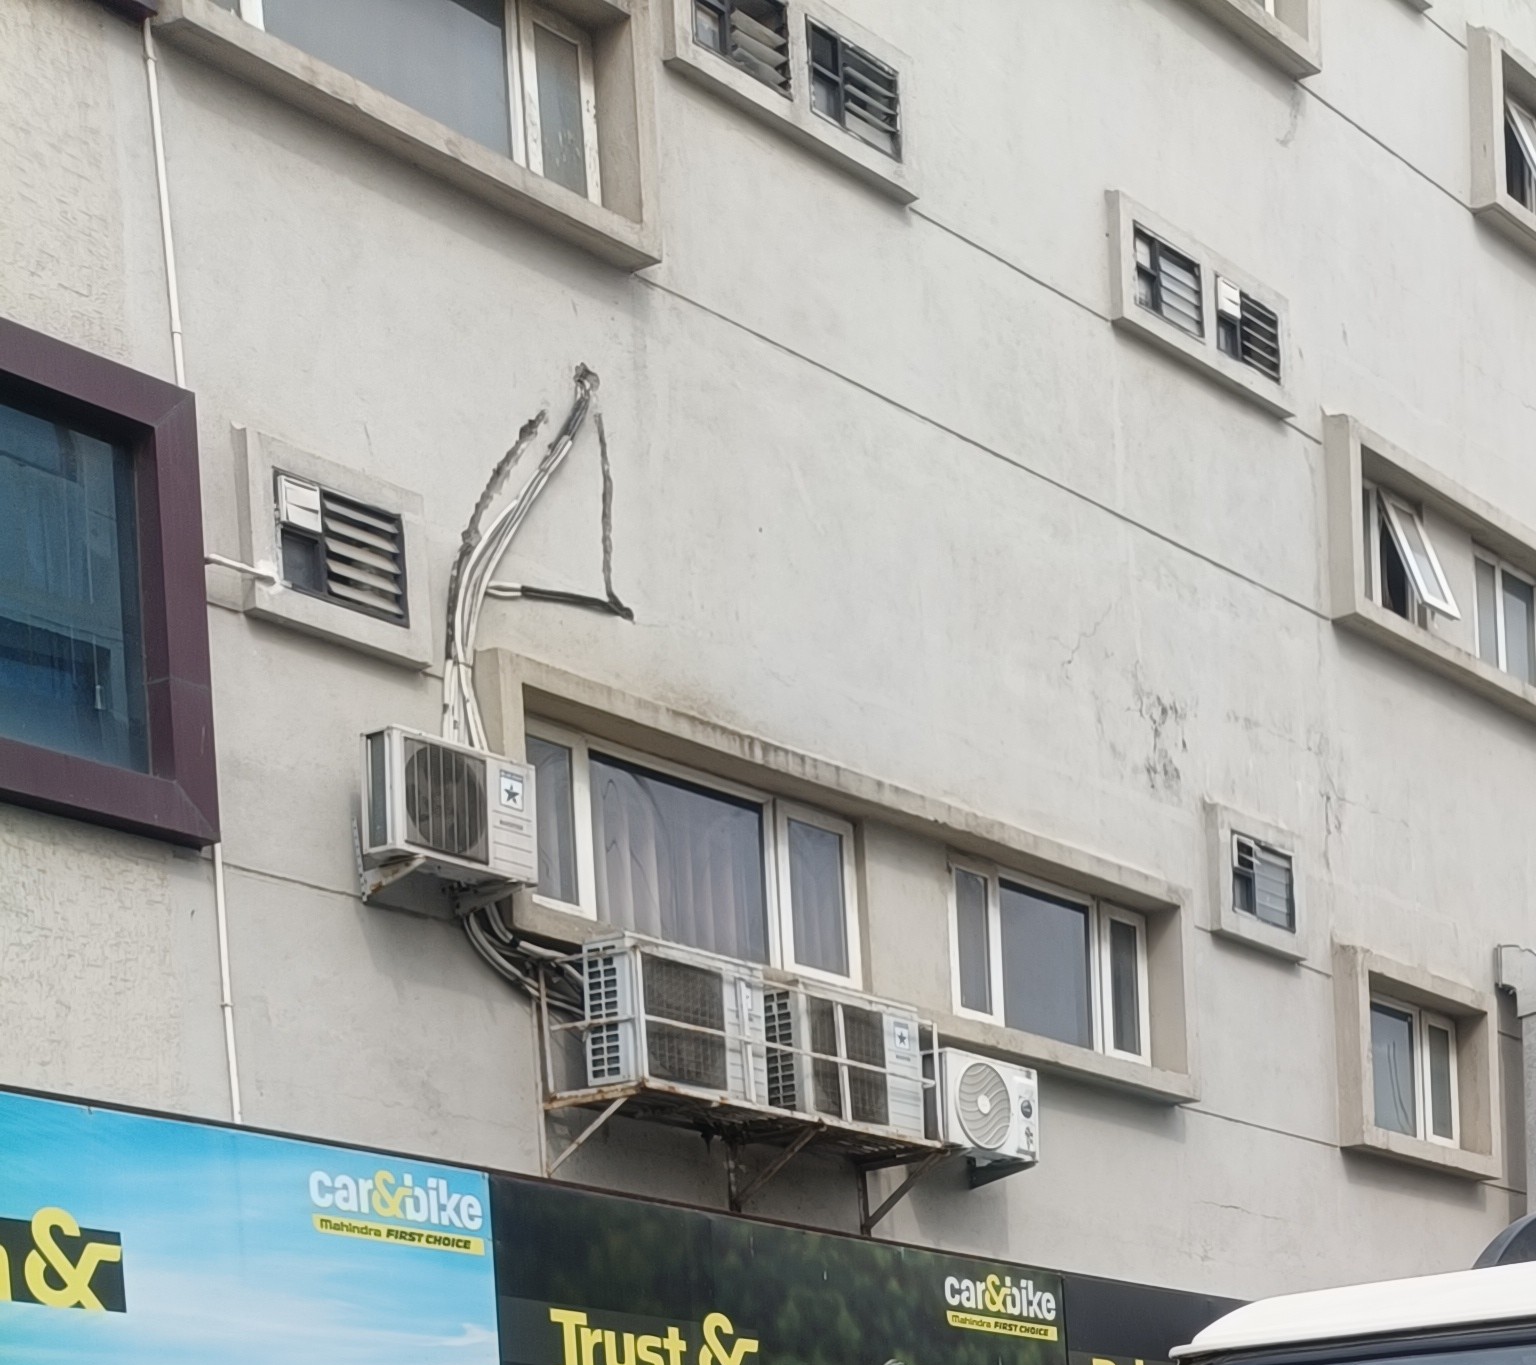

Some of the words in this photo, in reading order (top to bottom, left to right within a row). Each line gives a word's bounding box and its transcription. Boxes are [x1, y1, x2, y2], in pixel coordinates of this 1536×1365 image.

[309, 1170, 482, 1230] car&bike
[320, 1218, 382, 1237] Mahindra
[386, 1228, 425, 1243] FIRST
[426, 1234, 471, 1249] CHOICE
[945, 1273, 1056, 1320] car&bike
[952, 1314, 991, 1328] Mahindra
[994, 1321, 1018, 1332] FIRST
[1019, 1325, 1049, 1336] CHOICE
